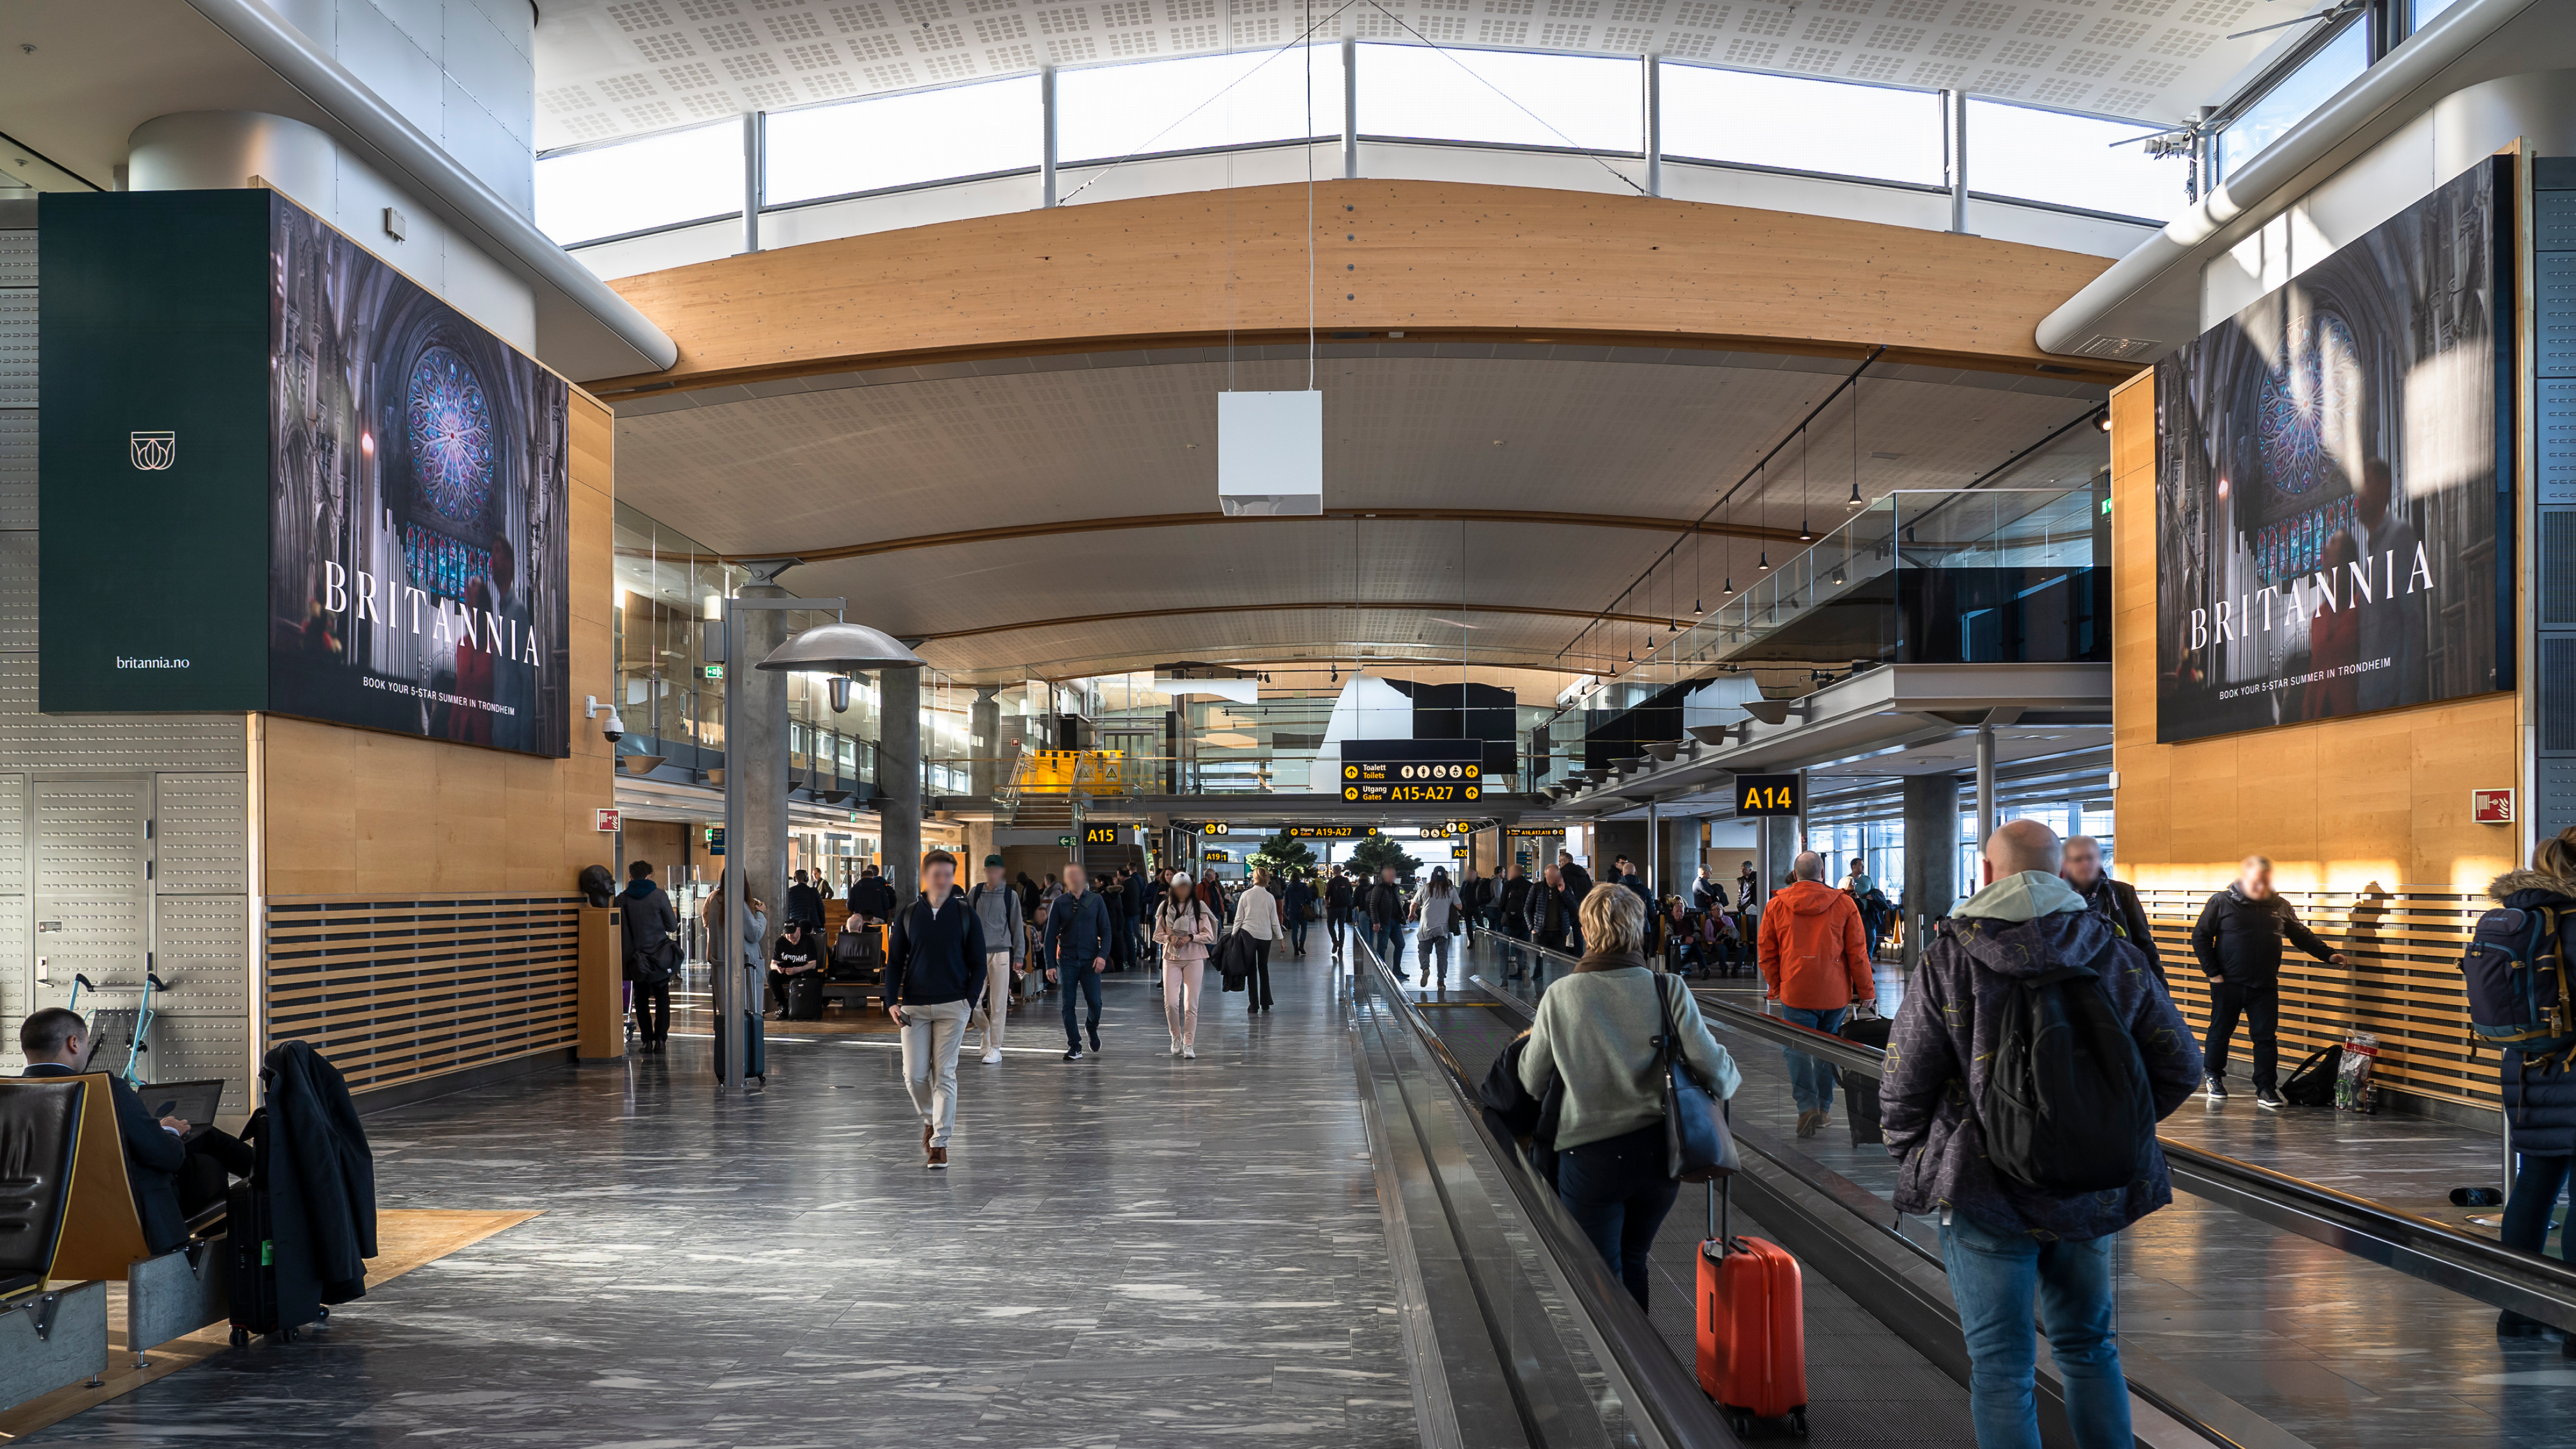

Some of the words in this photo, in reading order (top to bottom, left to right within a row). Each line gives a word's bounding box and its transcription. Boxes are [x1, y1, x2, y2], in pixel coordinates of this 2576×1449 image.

[2191, 541, 2434, 651] BRITANNIA
[325, 560, 539, 667] BRITANNIA
[116, 656, 190, 668] britannia.no
[2219, 688, 2238, 700] BOOK
[2241, 684, 2259, 696] YOUR
[2262, 678, 2288, 691] 5-STAR
[2290, 671, 2324, 685] SUMMER
[2327, 668, 2335, 678] IN
[2338, 657, 2390, 676] TRONDHEIM
[363, 676, 385, 690] BOOK
[388, 682, 408, 695] YOUR
[411, 687, 437, 700] 5-STAR
[438, 693, 467, 706] SUMMER
[469, 698, 476, 708] IN
[478, 700, 515, 716] TRONDHEIM
[1362, 785, 1387, 794] Utgang
[1391, 787, 1453, 800] A15-A27
[1744, 787, 1791, 808] A14
[1087, 829, 1114, 842] A15
[1316, 828, 1352, 836] A19-A27
